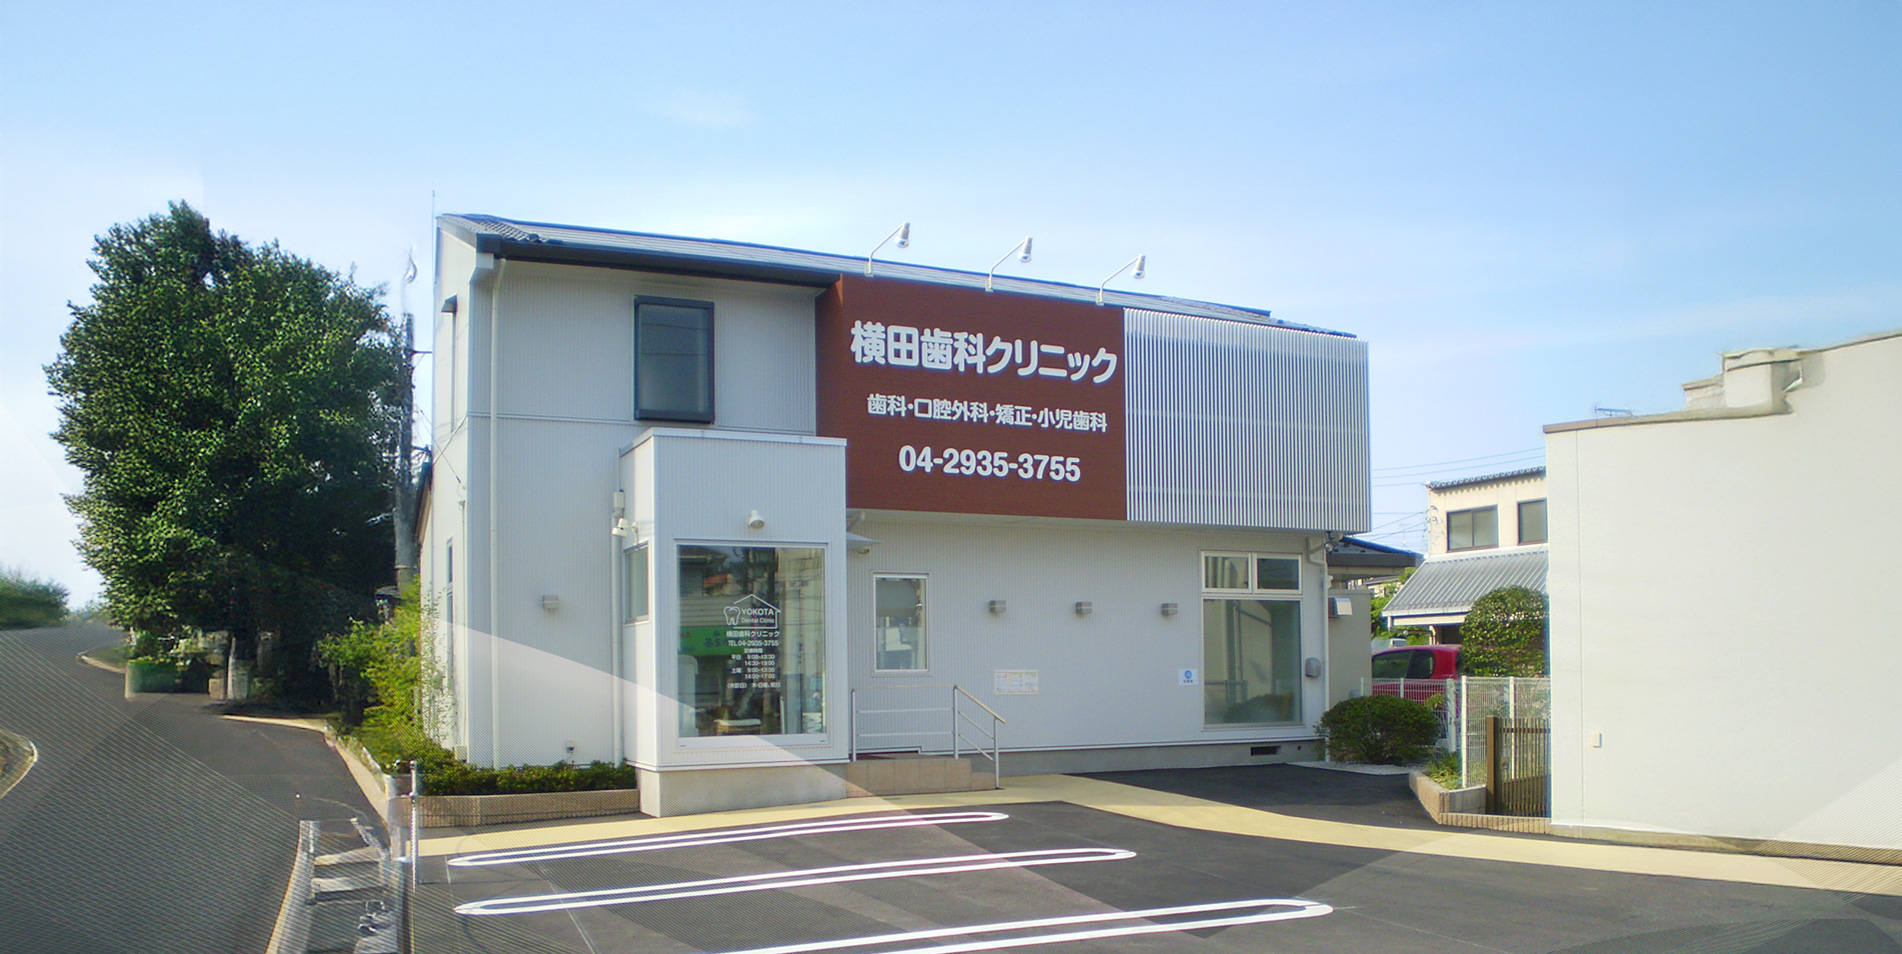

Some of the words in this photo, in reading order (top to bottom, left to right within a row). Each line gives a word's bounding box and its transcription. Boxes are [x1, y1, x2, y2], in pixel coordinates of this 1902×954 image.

[850, 320, 1118, 384] 横田歯科クリニック
[899, 445, 1081, 482] 04-2935-3755
[741, 608, 774, 616] YOKOTA
